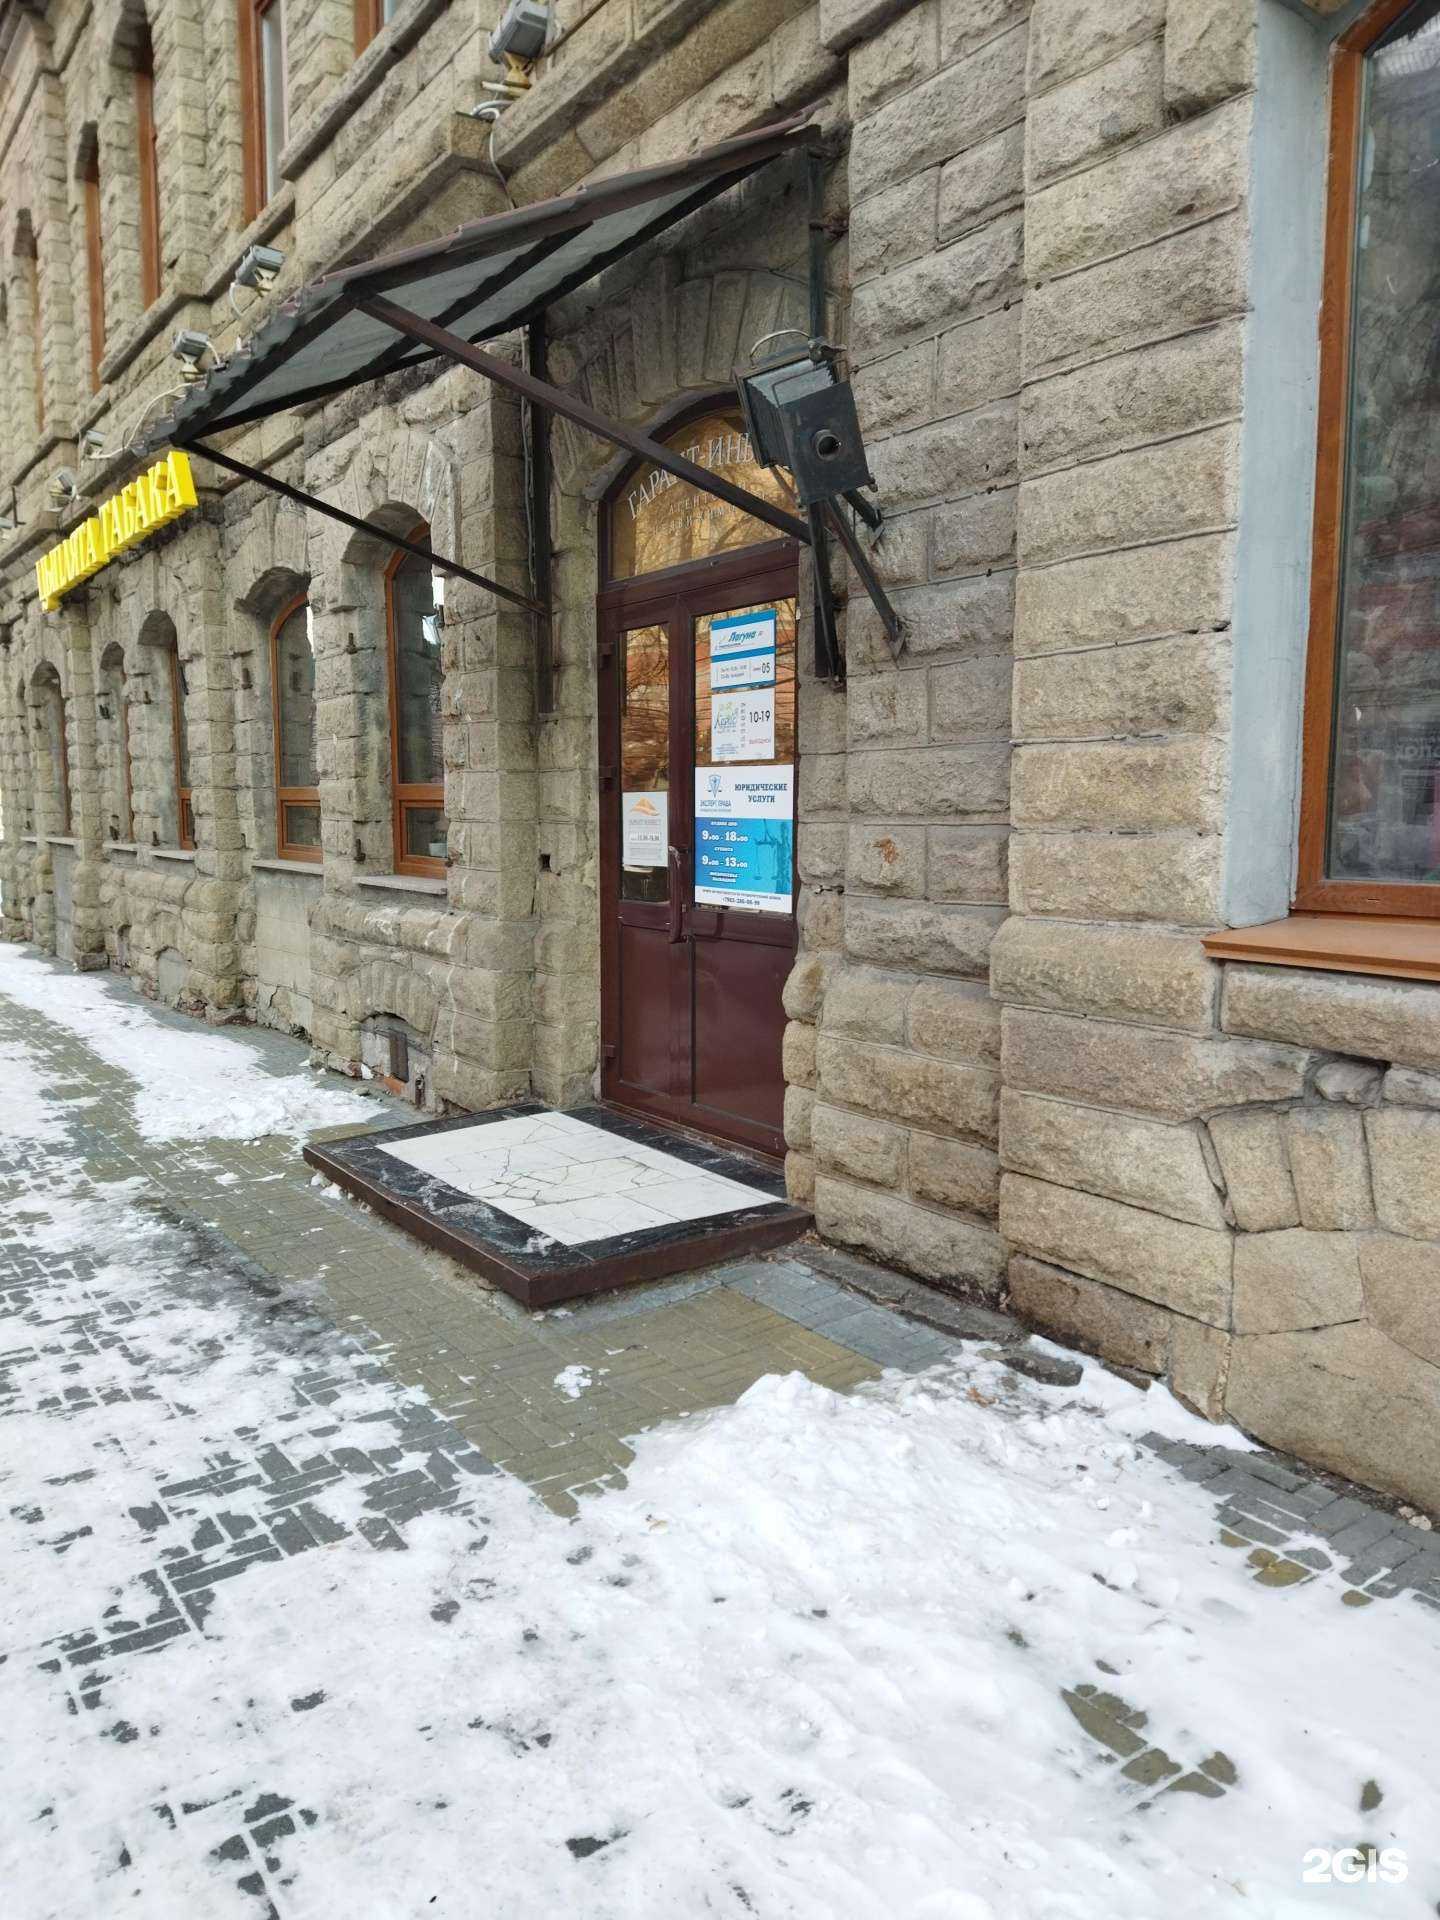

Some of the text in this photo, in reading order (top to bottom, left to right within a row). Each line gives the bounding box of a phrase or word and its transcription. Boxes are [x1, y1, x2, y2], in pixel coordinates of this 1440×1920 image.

[98, 451, 199, 555] ТАБАКА
[761, 662, 771, 674] 05
[749, 710, 771, 723] 10-19
[734, 783, 788, 792] ЮРИДИЧЕСКИЕ
[748, 795, 775, 803] УСЛУГИ
